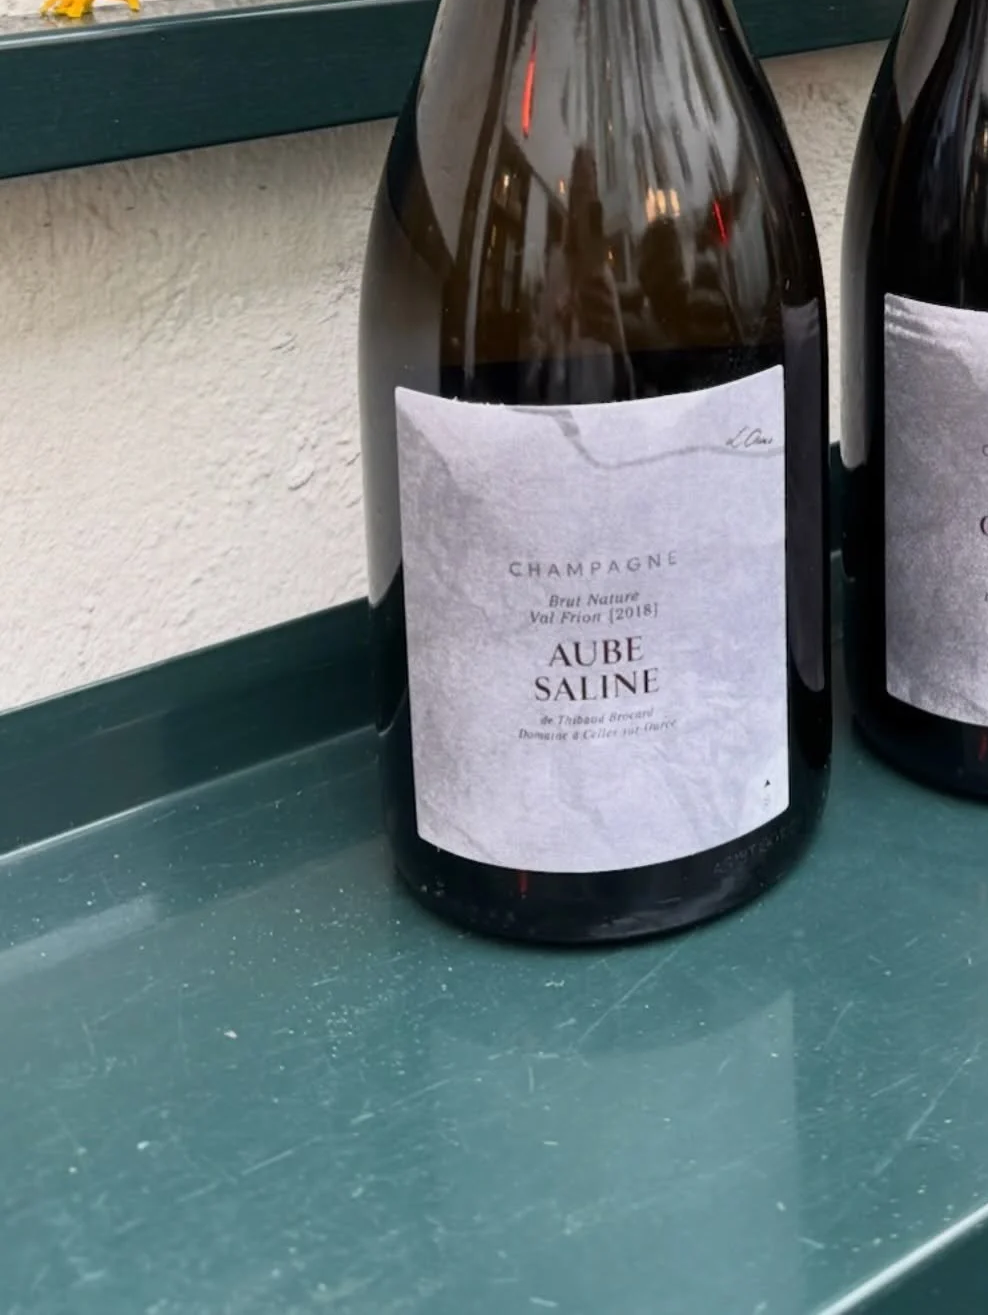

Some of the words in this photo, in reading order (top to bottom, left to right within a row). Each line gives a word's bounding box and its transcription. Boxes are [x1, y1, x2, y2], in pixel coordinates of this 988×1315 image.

[508, 549, 678, 577] CHAMPAGNE
[529, 610, 555, 625] Val
[560, 611, 602, 625] Frion
[609, 601, 659, 624] [2018]
[548, 593, 582, 609] Brut
[587, 590, 640, 606] Nature
[548, 635, 645, 668] AUBE
[534, 667, 660, 702] SALINE
